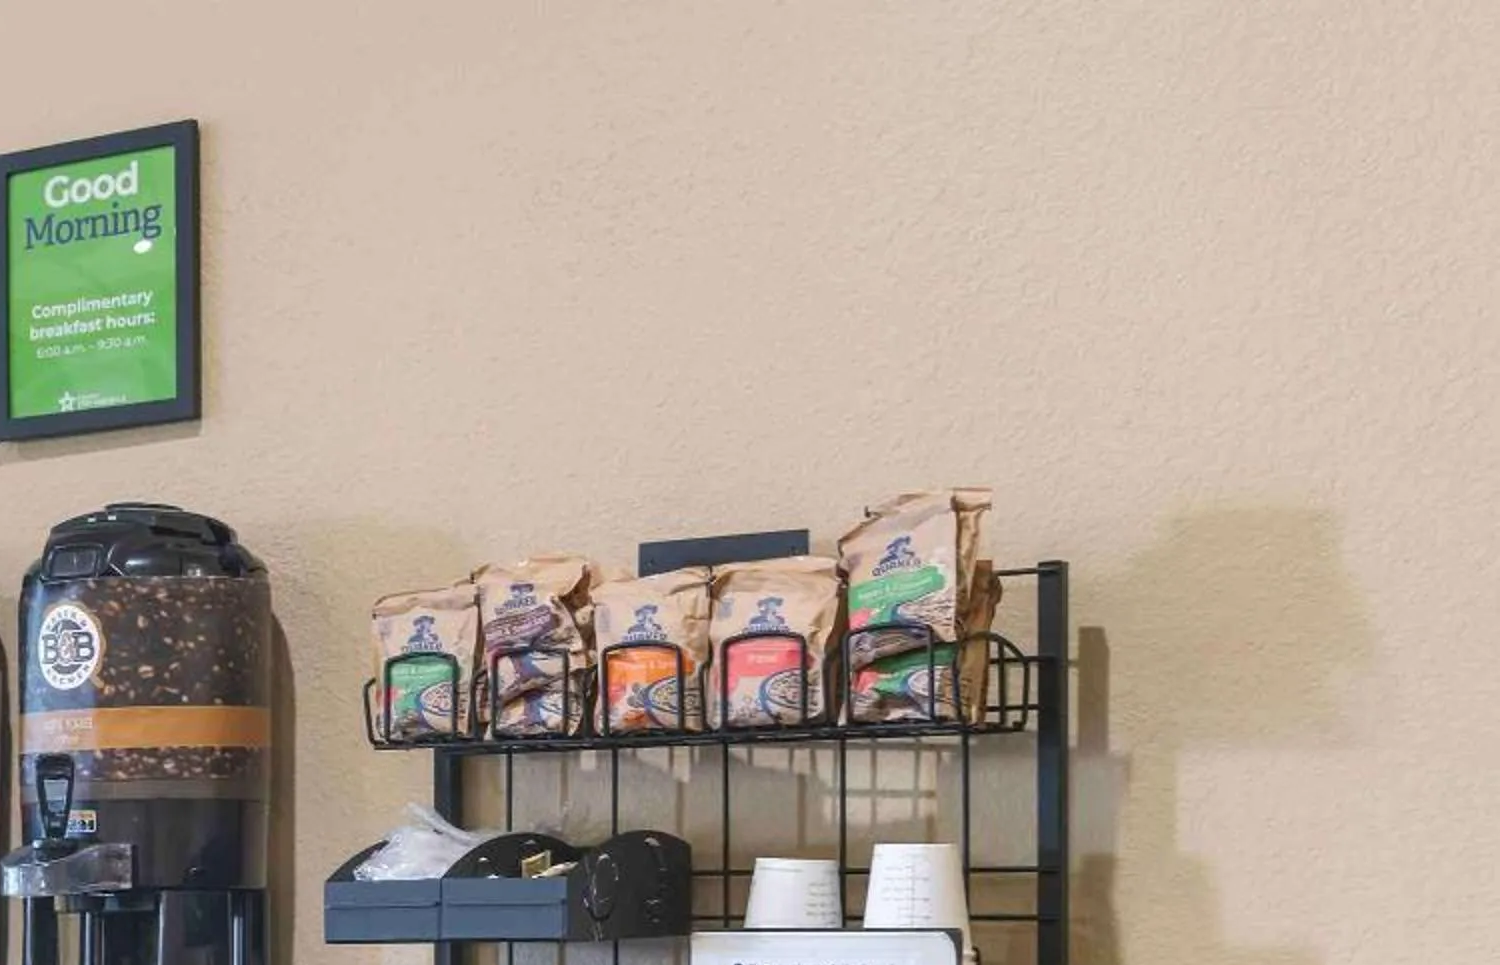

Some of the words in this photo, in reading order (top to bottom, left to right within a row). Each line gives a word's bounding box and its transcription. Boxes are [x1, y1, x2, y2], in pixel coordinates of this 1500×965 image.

[44, 160, 138, 208] Good
[24, 201, 163, 250] Morning
[31, 289, 154, 319] Complimentary
[29, 319, 102, 342] breakfast
[105, 310, 156, 329] hours:
